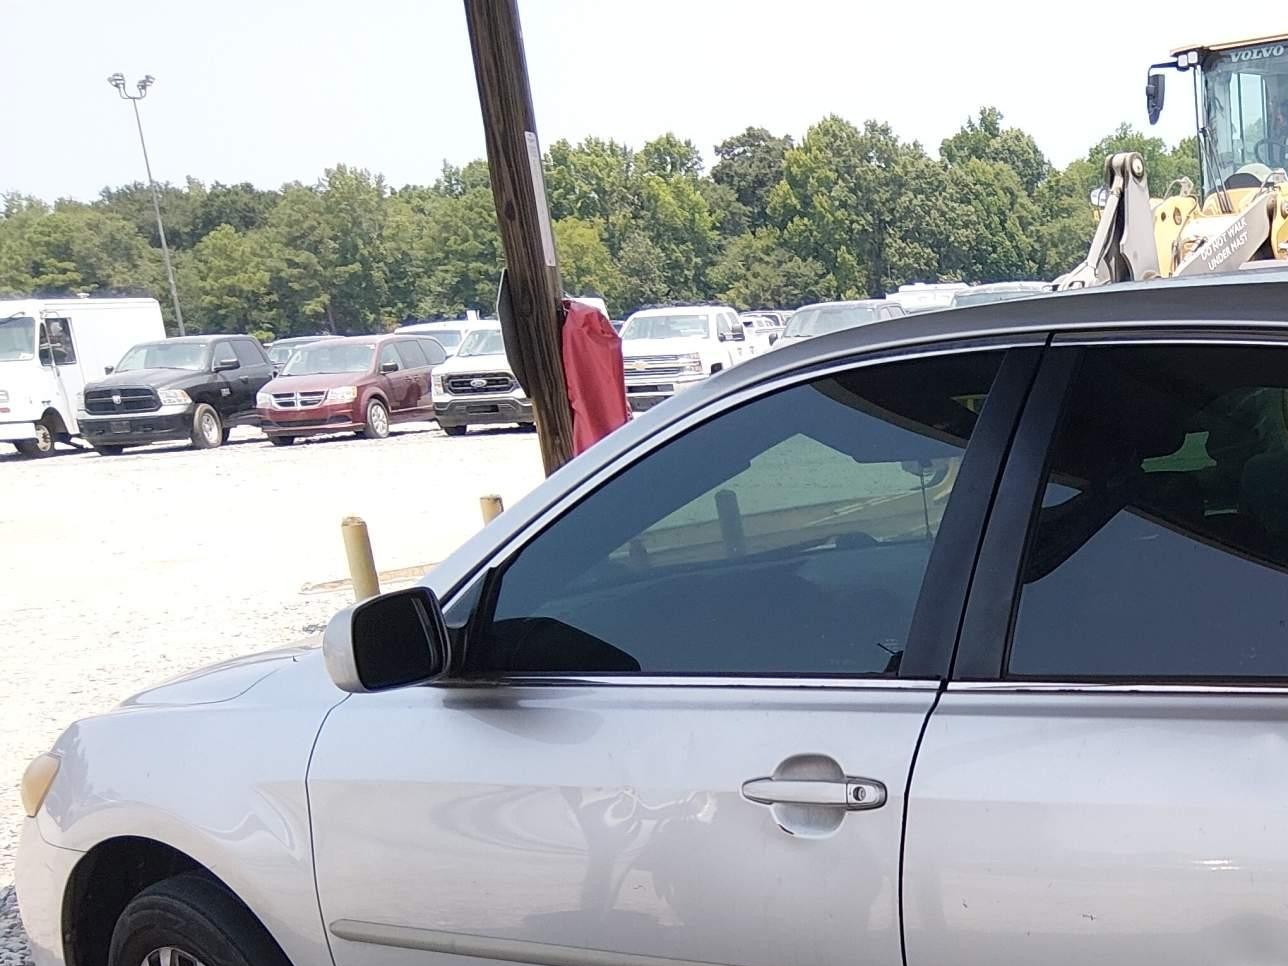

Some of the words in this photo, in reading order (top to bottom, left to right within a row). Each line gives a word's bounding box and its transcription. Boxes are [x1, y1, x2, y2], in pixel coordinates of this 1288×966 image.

[1230, 45, 1284, 62] VOLVO
[1200, 245, 1213, 260] DO
[1211, 232, 1227, 252] NOT
[1226, 217, 1248, 238] WALK
[1208, 246, 1232, 270] UNDER
[1230, 231, 1248, 252] MAST
